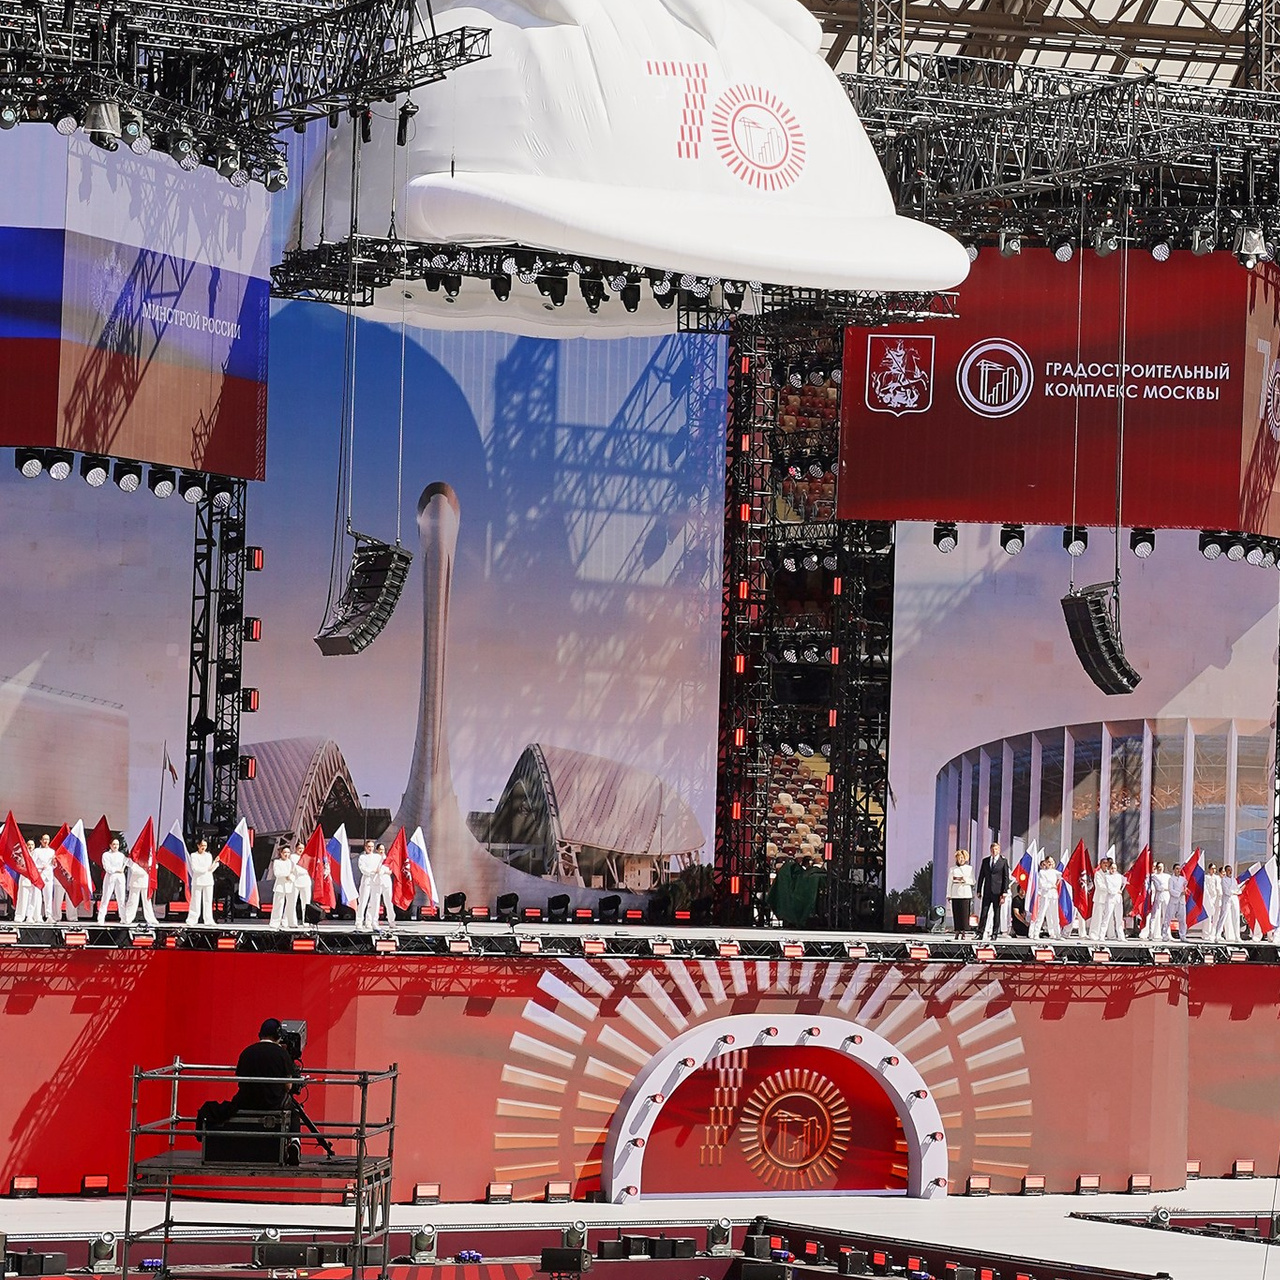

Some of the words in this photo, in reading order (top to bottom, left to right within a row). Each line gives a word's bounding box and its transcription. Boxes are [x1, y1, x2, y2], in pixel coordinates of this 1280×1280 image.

[142, 301, 200, 330] МИНСТРОЙ
[202, 315, 241, 339] РОССИИ
[1045, 361, 1231, 381] ГРАДОСТРОИТЕЛЬНЫЙ
[1045, 383, 1139, 400] КОМПЛЕКС
[1143, 384, 1220, 401] МОСКВЫ
